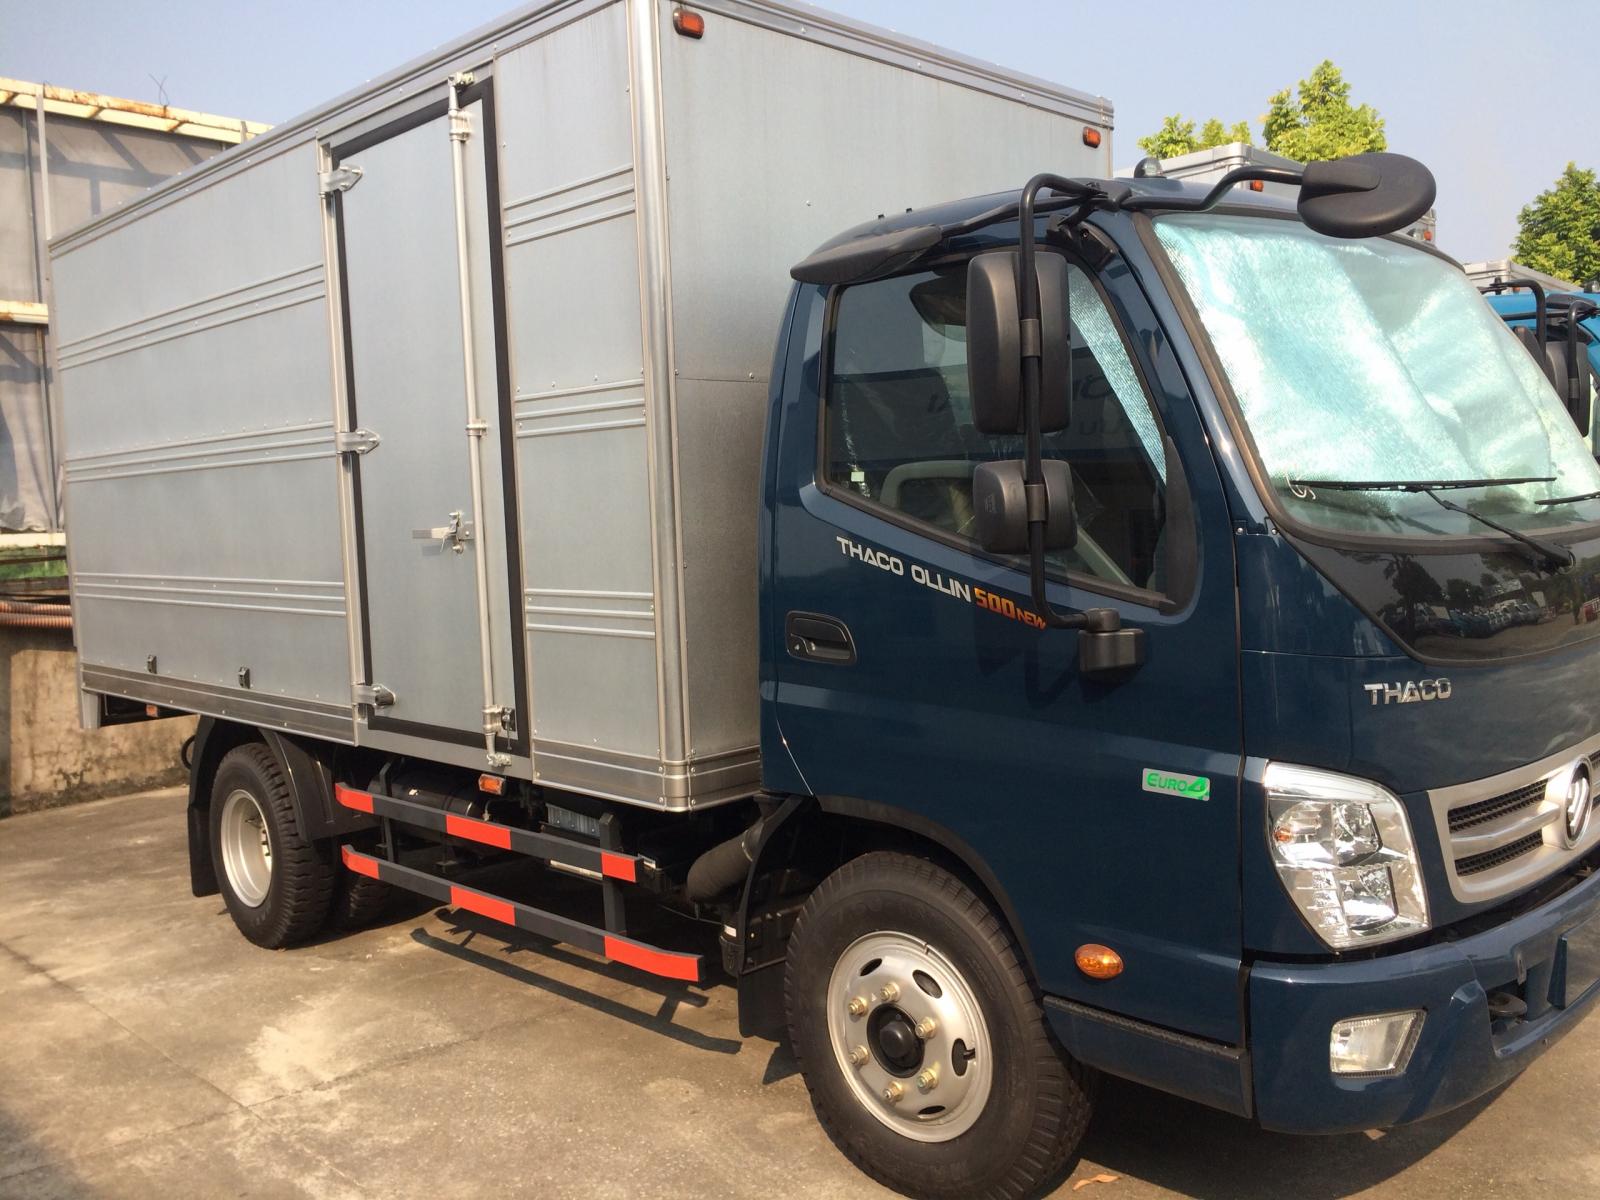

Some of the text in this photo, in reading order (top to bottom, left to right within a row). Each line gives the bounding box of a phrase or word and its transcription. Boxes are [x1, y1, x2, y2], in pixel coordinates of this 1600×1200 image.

[836, 536, 1046, 630] THACO OLLIN 500 NEW
[1364, 678, 1452, 705] THACO
